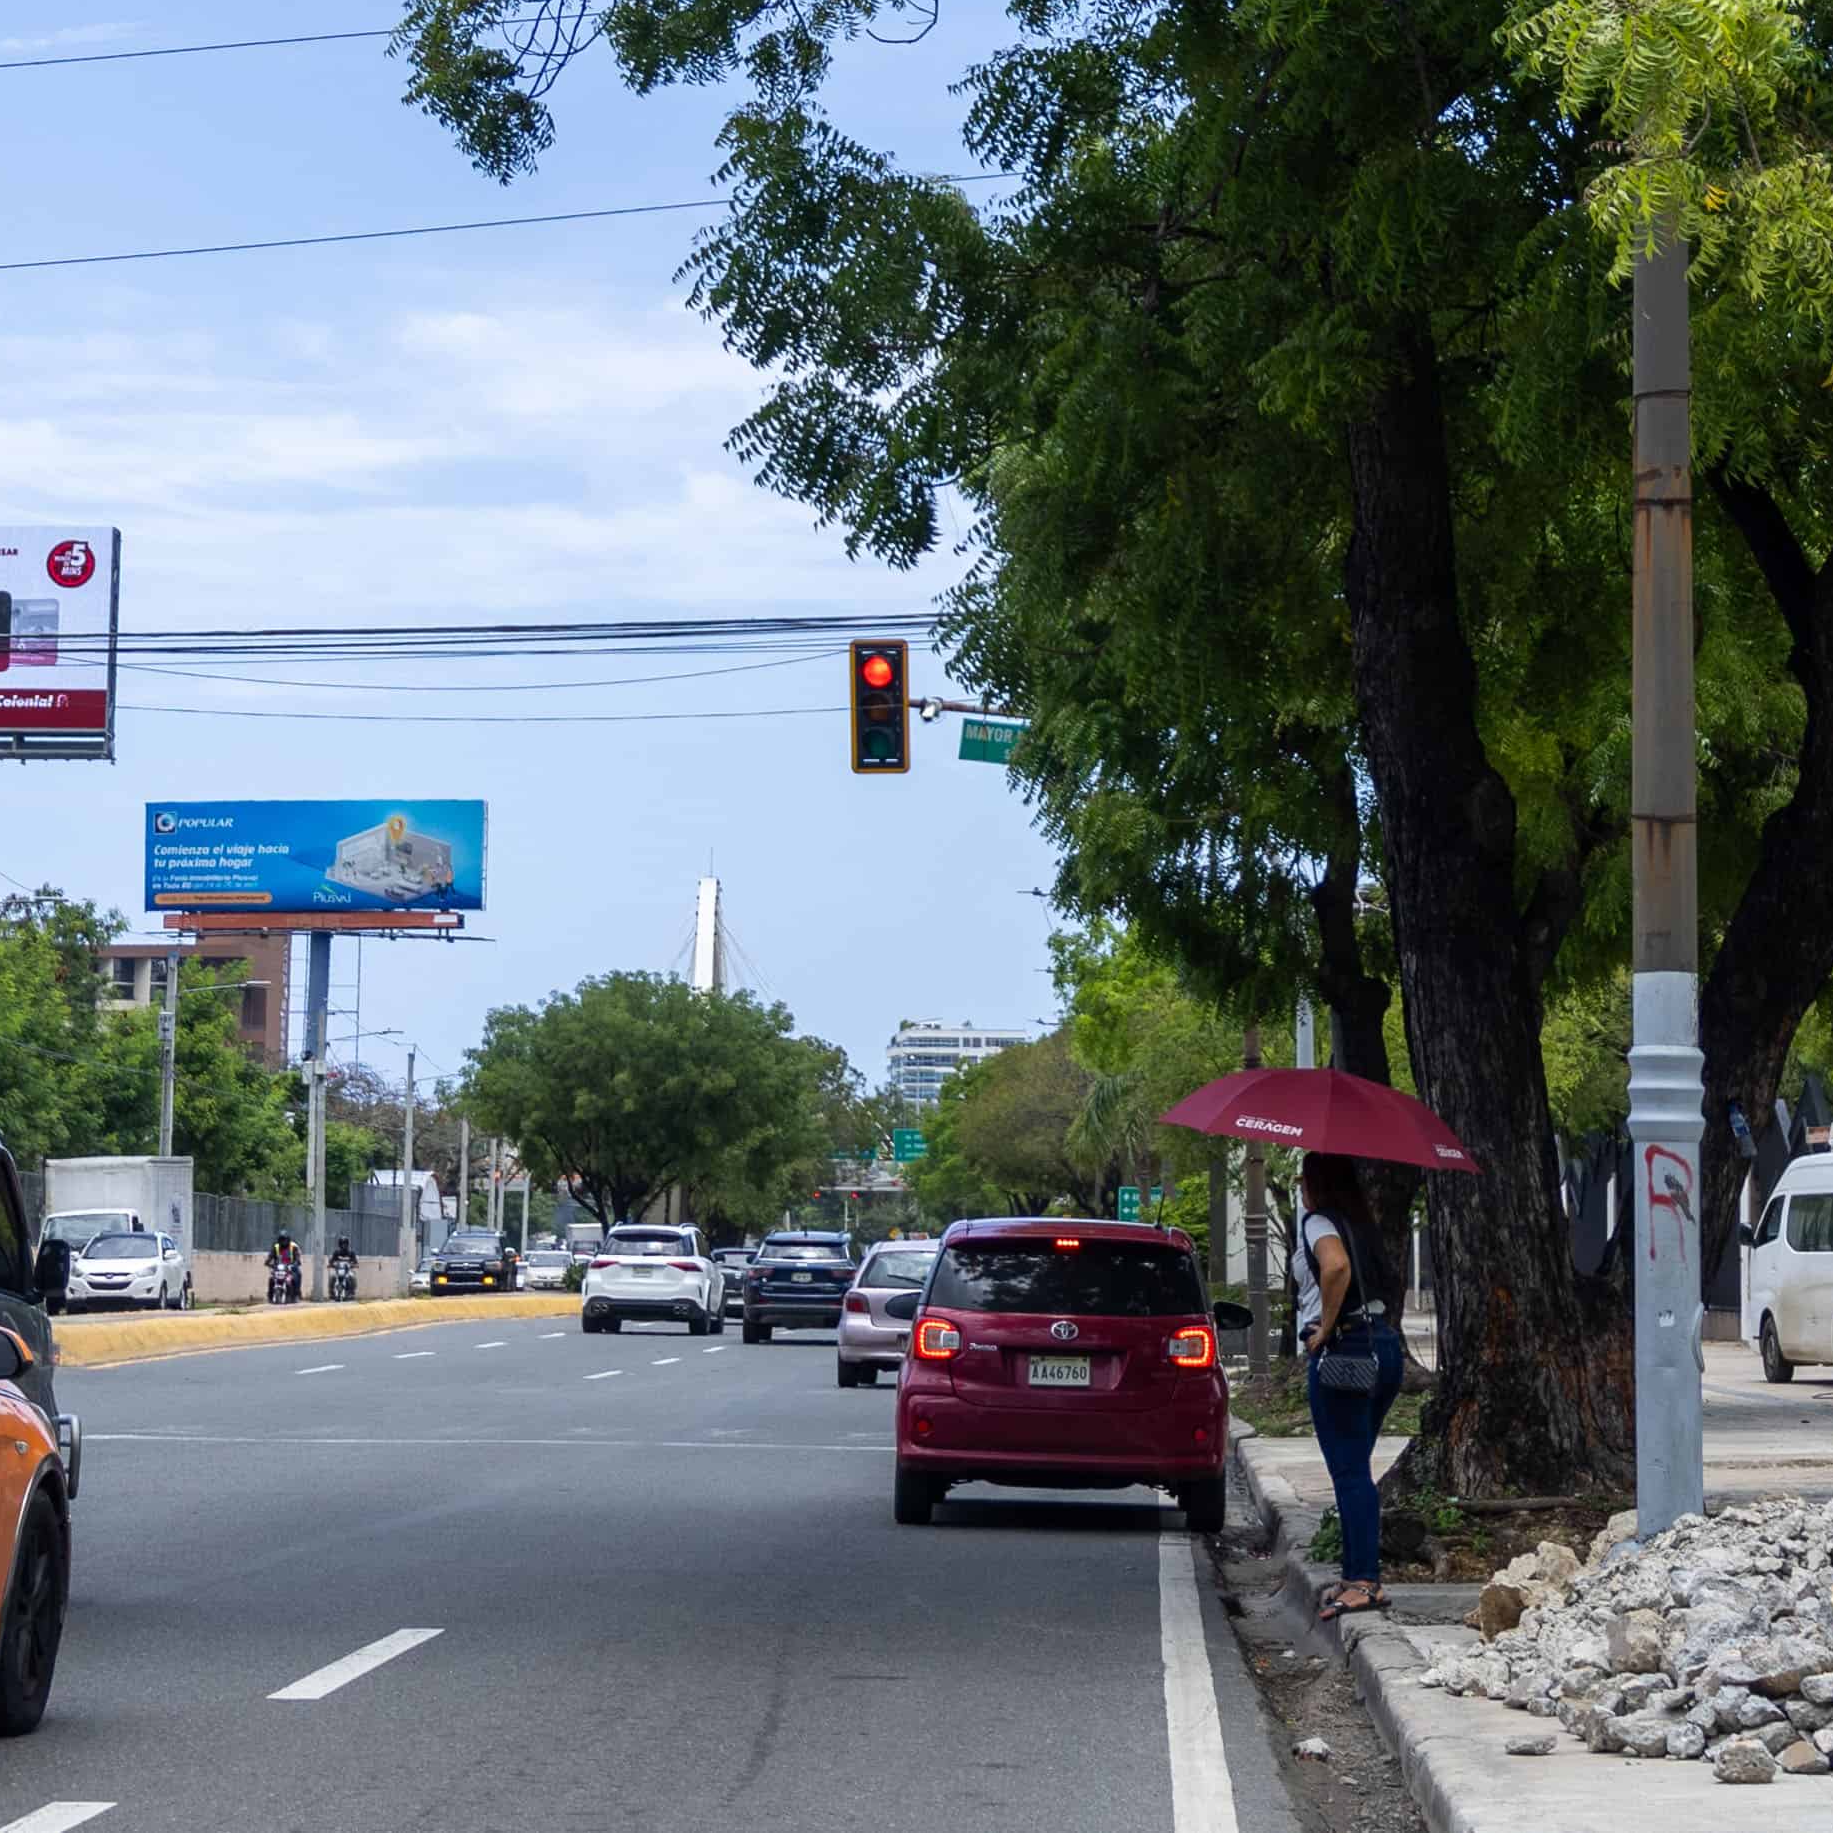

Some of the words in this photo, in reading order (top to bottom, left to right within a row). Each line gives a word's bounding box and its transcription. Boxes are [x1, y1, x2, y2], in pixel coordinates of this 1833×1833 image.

[70, 543, 87, 567] 5
[966, 724, 1013, 743] MAYOR
[178, 817, 234, 828] POPULAR
[154, 844, 210, 856] Comienza
[213, 844, 224, 855] el
[226, 844, 256, 857] viaje
[258, 844, 289, 855] hacia
[154, 857, 166, 868] tu
[168, 857, 216, 869] próximo
[218, 856, 254, 869] hogar
[1234, 1117, 1304, 1138] CERAGEM
[1031, 1365, 1088, 1380] AA46760
